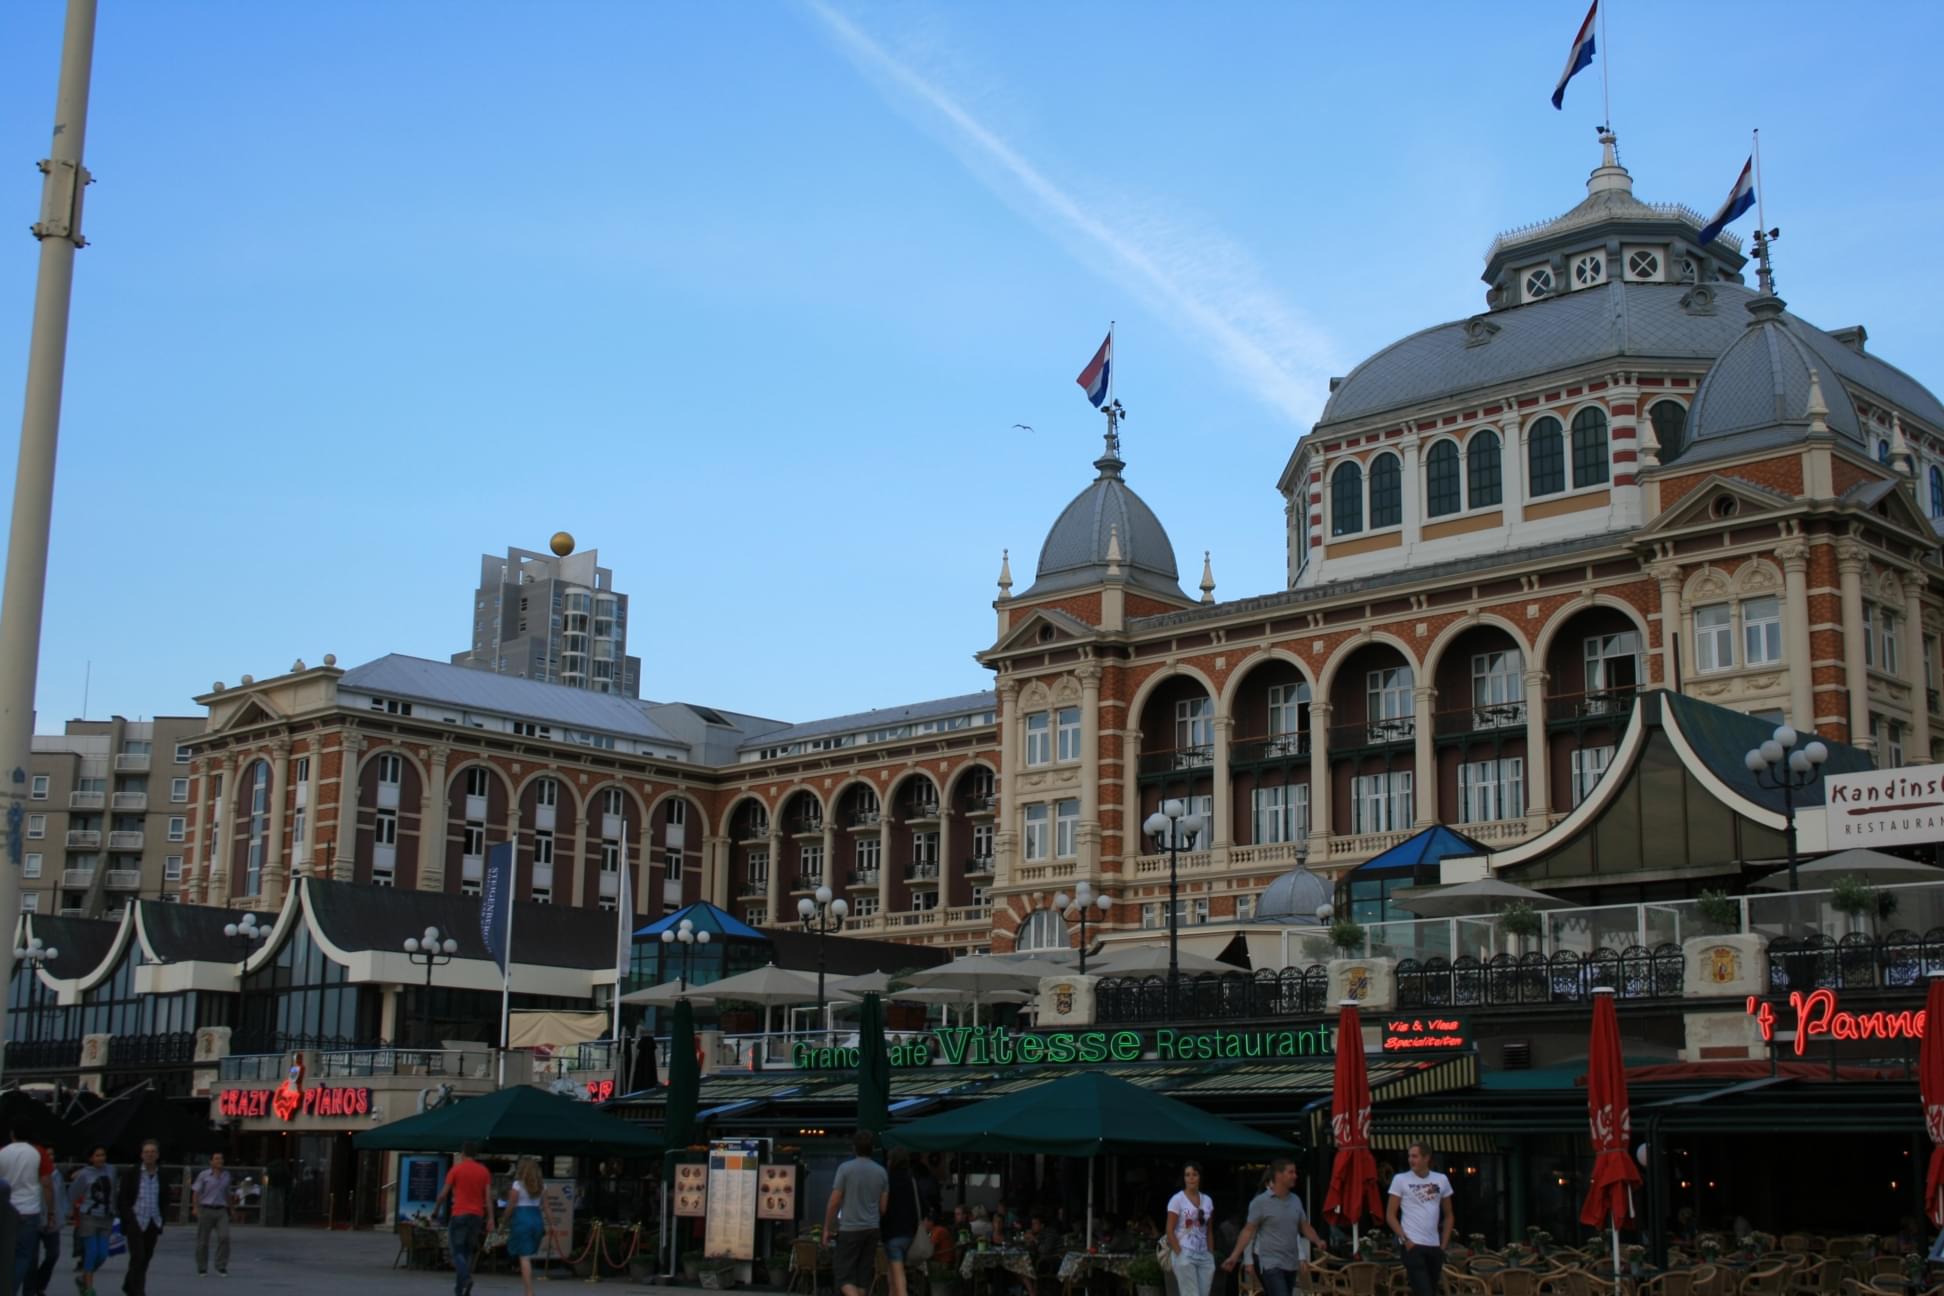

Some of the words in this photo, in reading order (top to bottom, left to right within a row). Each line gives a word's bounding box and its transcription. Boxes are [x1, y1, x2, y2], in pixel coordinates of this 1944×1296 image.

[1412, 1019, 1423, 1032] &
[933, 1026, 1141, 1065] Vitesse
[1156, 1023, 1329, 1059] Restaurant
[219, 1089, 270, 1116] CRAZY
[302, 1084, 370, 1116] PIANOS
